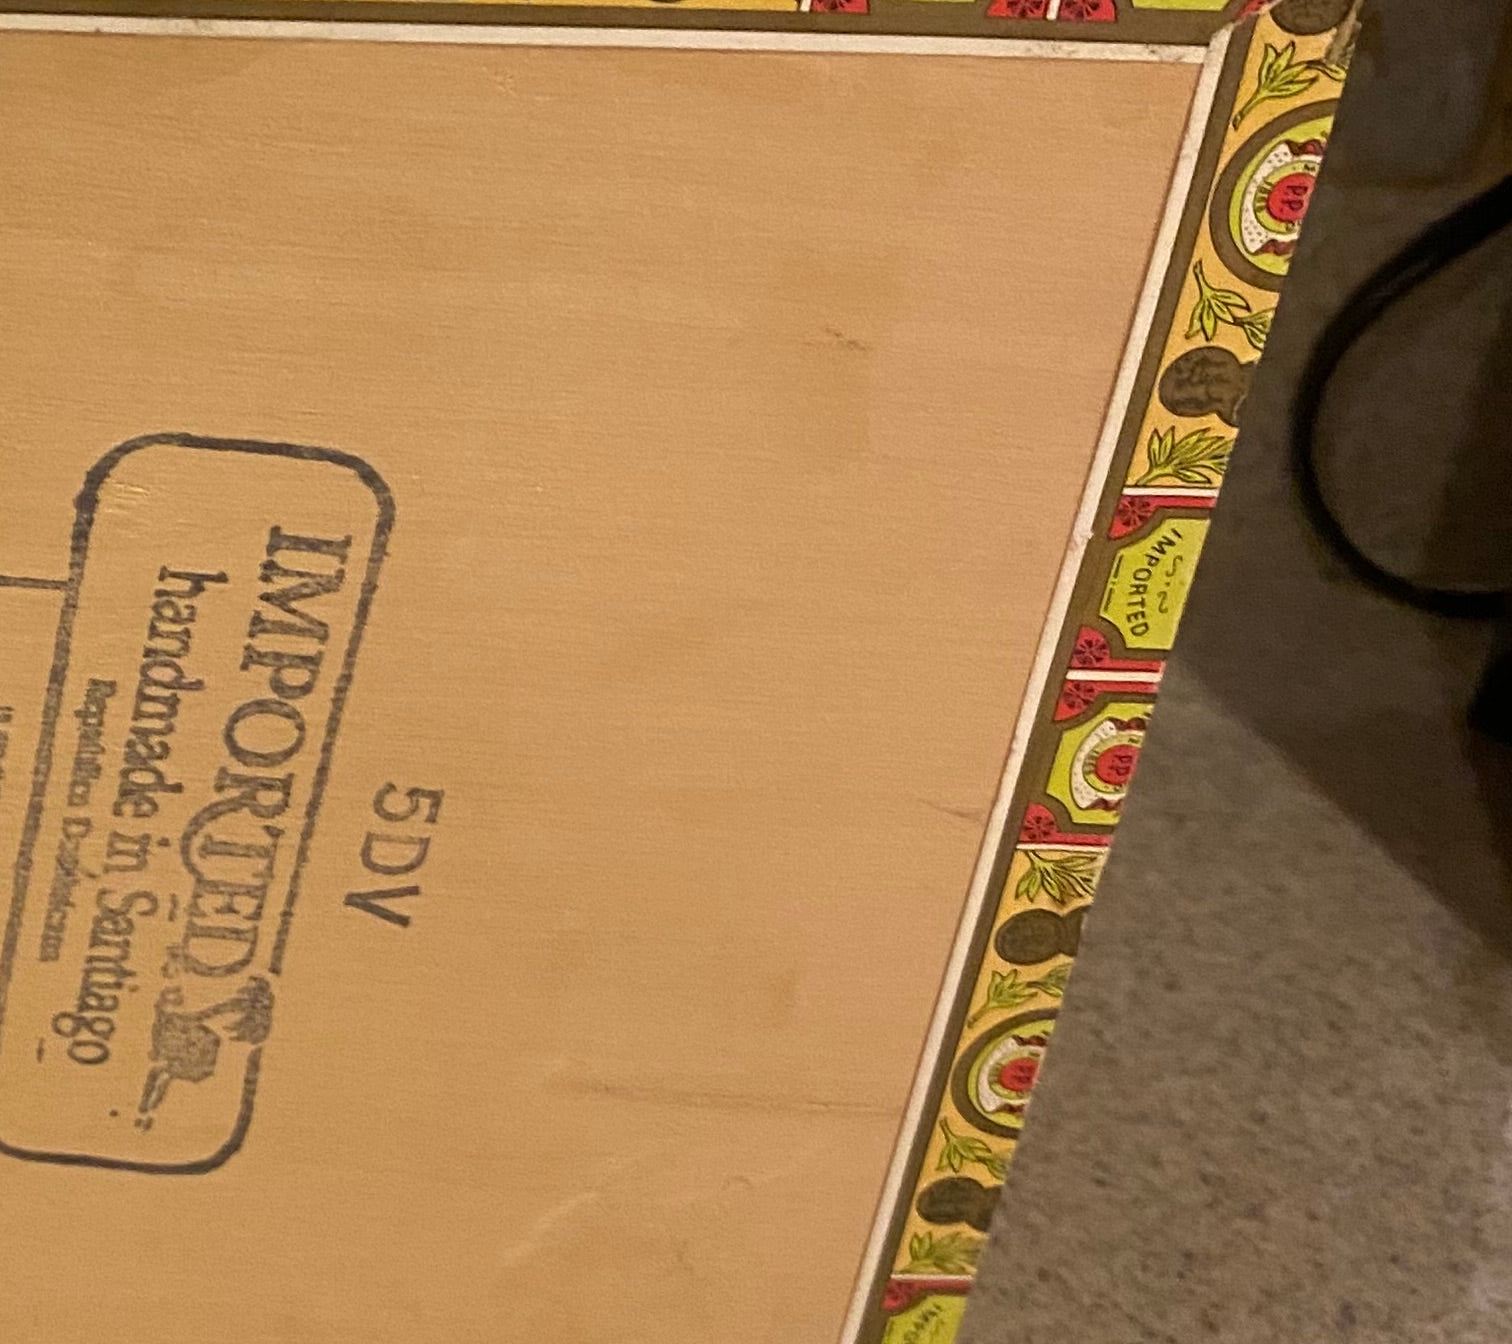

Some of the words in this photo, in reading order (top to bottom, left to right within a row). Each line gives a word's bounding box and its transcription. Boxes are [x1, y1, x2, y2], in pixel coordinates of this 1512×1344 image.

[1126, 527, 1184, 637] IMPORTED
[112, 564, 229, 818] handmade
[179, 524, 354, 978] IMPORTED
[103, 830, 171, 874] in
[51, 887, 159, 1065] Santiago
